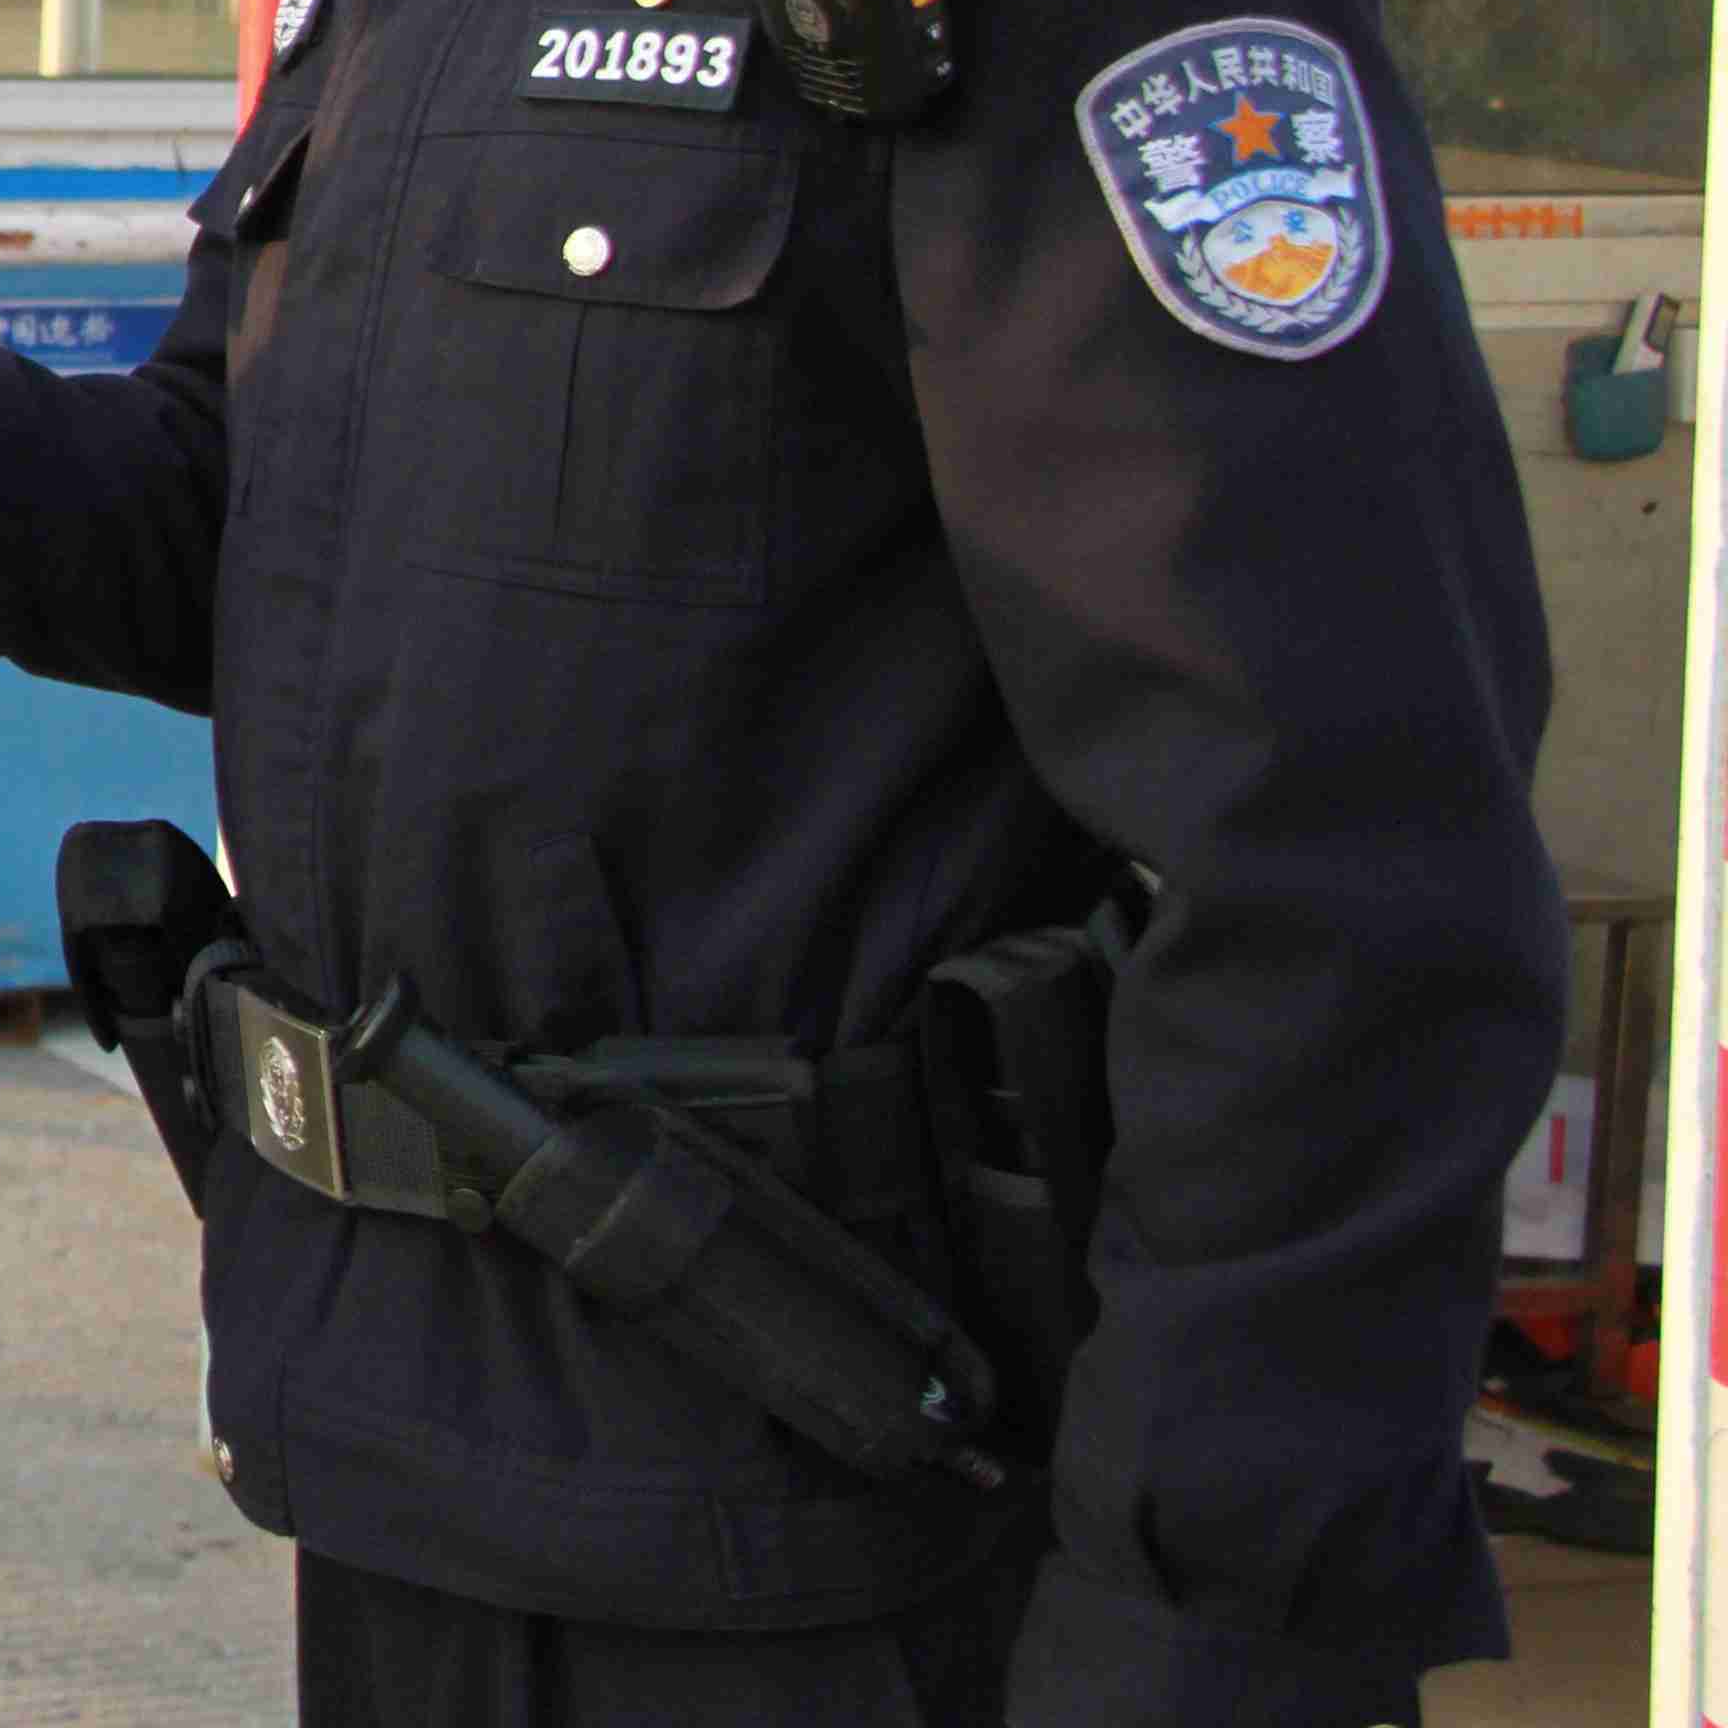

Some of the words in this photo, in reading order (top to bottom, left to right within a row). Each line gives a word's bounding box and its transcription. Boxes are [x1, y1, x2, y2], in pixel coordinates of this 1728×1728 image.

[530, 29, 736, 87] 201893
[1110, 46, 1337, 139] 中华人民共和国
